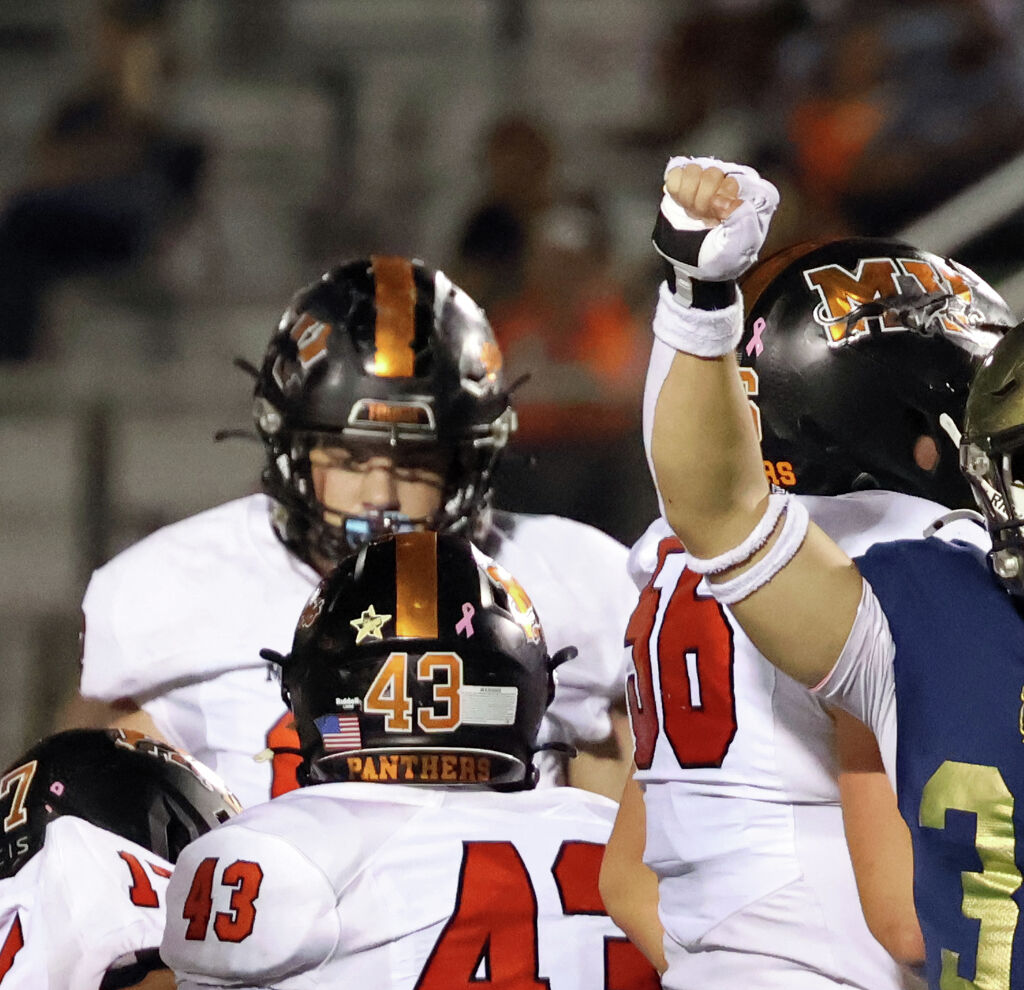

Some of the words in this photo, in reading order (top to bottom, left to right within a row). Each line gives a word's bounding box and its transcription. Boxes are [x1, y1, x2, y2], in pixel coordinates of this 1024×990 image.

[363, 652, 464, 733] 43
[347, 754, 492, 783] PANTHERS
[183, 857, 264, 944] 43
